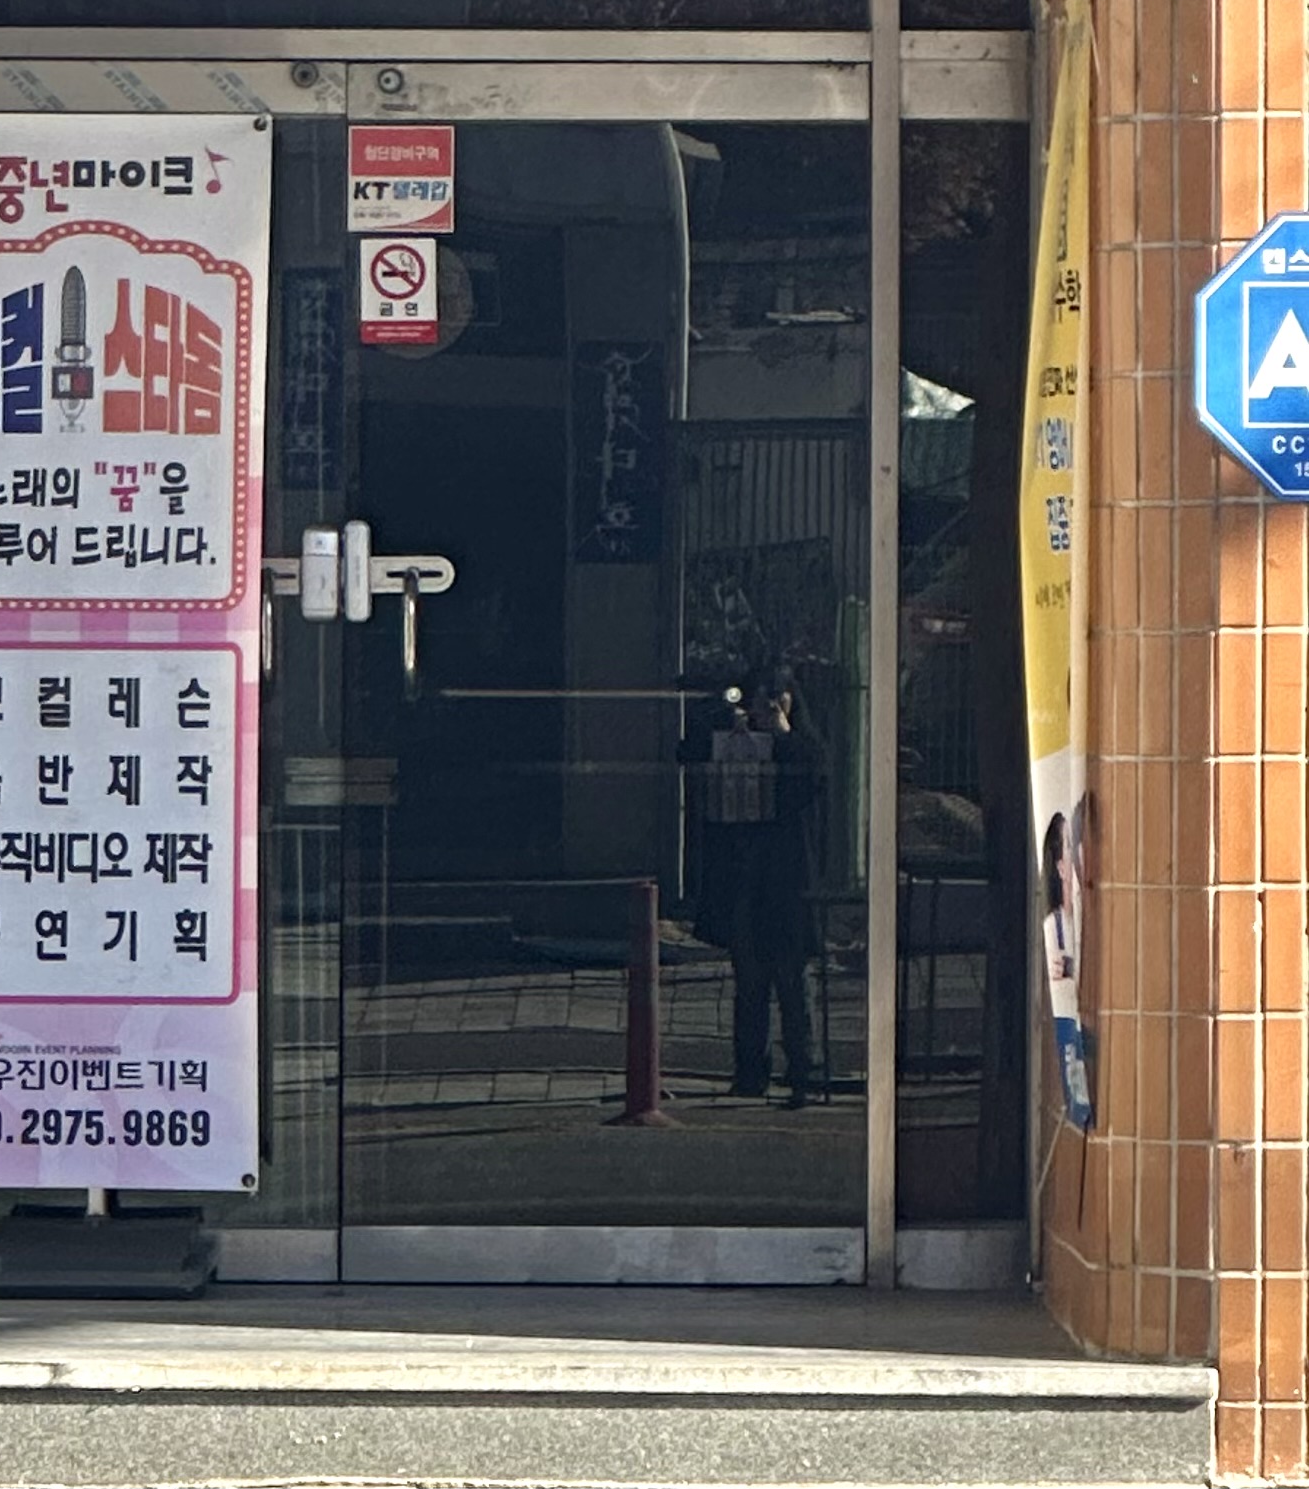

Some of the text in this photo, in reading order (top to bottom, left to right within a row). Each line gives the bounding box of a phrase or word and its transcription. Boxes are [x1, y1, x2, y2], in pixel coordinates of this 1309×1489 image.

[1272, 435, 1309, 454] CC
[71, 523, 218, 569] 드립니다.
[143, 831, 213, 885] 제작
